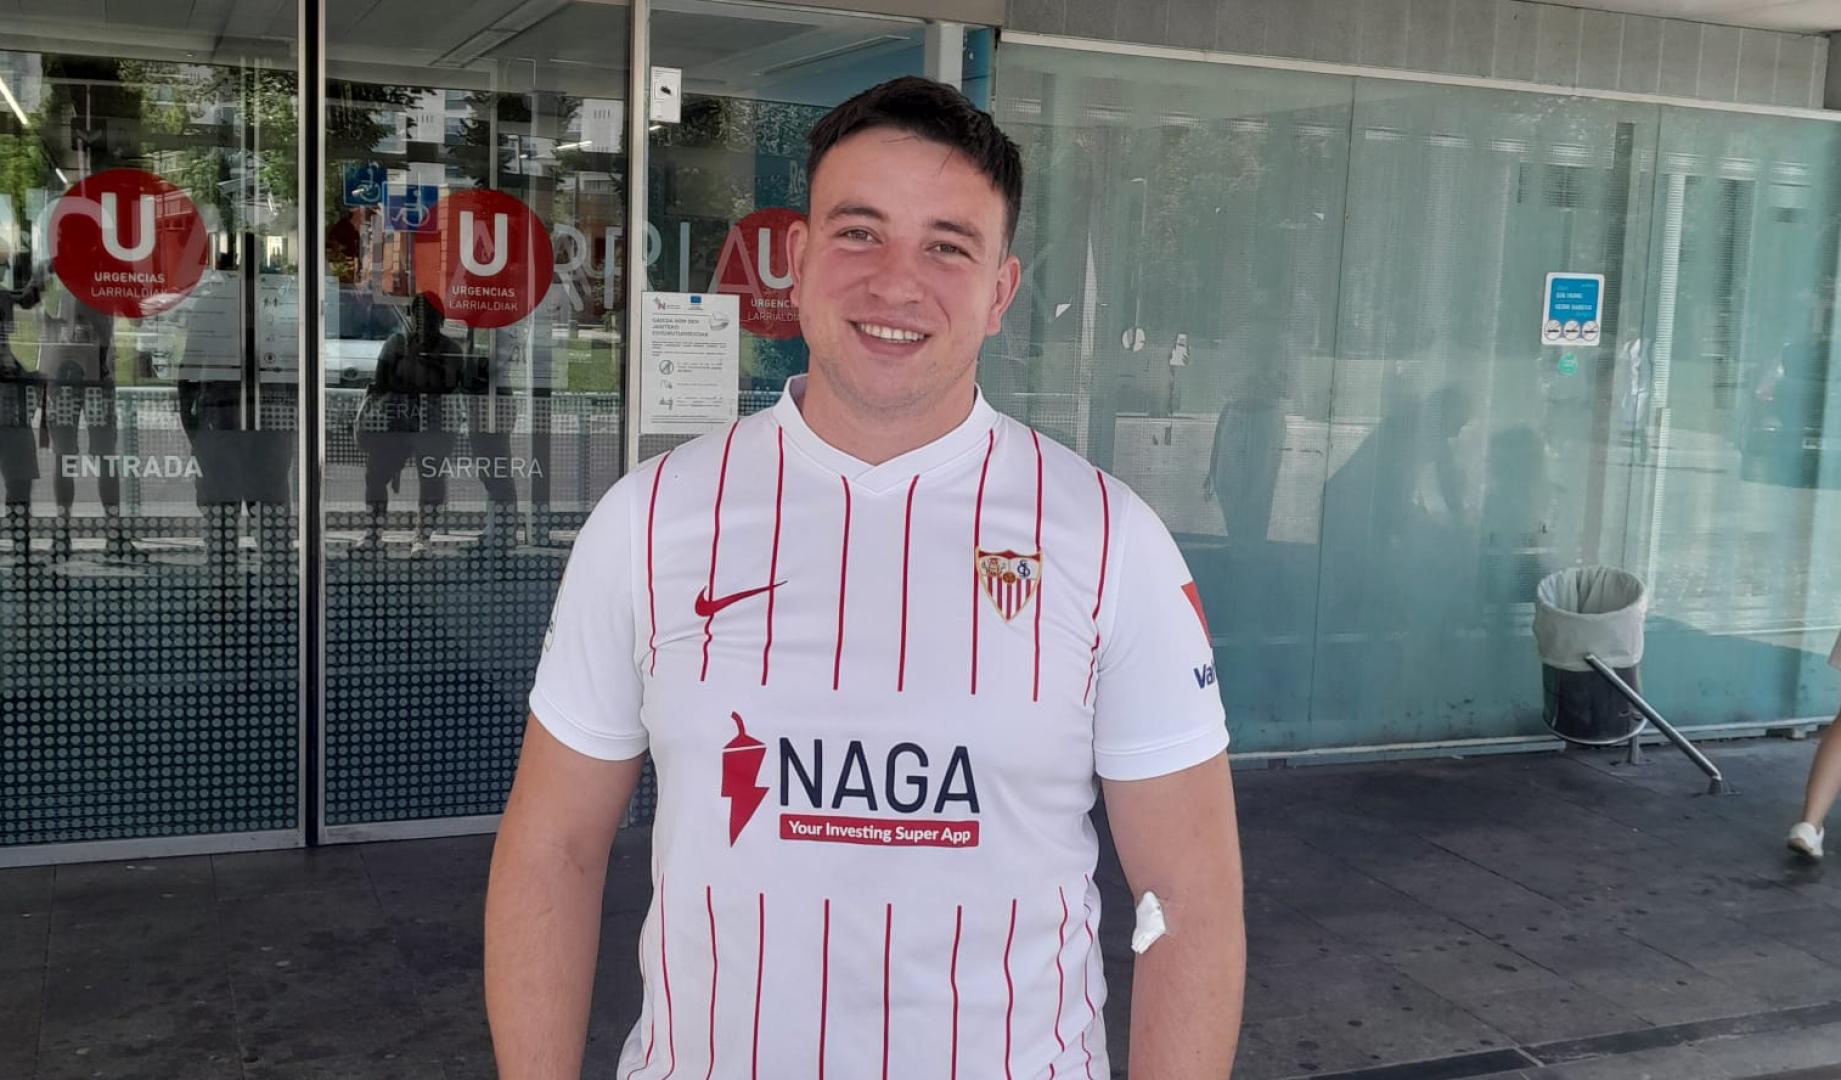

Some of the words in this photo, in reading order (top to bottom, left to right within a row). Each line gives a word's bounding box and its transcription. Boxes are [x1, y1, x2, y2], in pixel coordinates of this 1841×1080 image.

[101, 192, 156, 262] U
[460, 210, 508, 276] U
[94, 271, 166, 284] URGENCIAS
[452, 286, 515, 298] URGENCIAS
[751, 298, 793, 308] URGENC
[449, 300, 518, 312] LARRIALDIAK
[61, 455, 204, 478] ENTRADA
[421, 456, 544, 479] SARRERA
[1193, 662, 1216, 689] Va
[779, 737, 980, 814] NAGA
[788, 820, 823, 836] Your
[826, 822, 892, 842] Investing
[895, 826, 939, 843] Super
[941, 828, 971, 844] App
